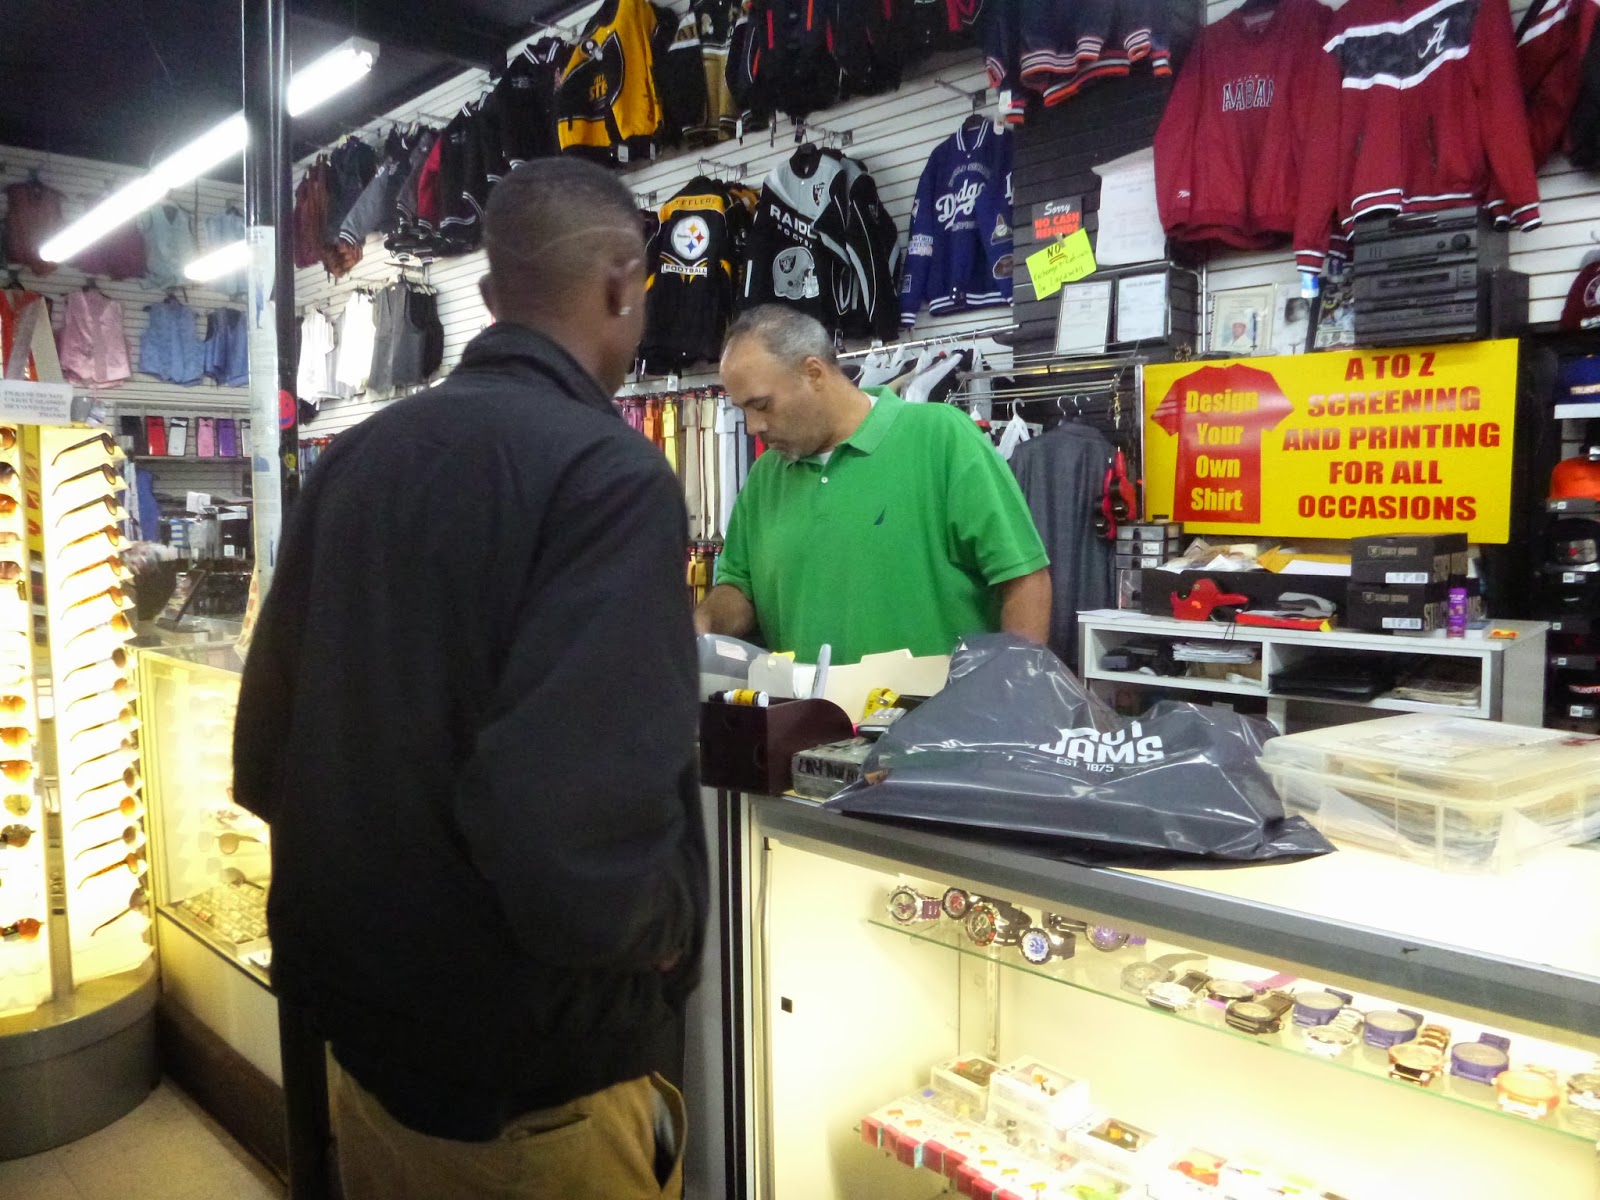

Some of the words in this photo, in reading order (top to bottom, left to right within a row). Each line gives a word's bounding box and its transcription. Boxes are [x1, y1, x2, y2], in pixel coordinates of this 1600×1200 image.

[1034, 217, 1050, 229] NO
[1053, 211, 1080, 225] CASH
[1043, 202, 1071, 216] Sorry
[1047, 244, 1062, 259] NO
[664, 263, 707, 274] FOOTBALL
[1344, 357, 1364, 382] A
[1372, 354, 1414, 380] TO
[1419, 352, 1436, 377] Z
[1185, 389, 1258, 414] Design
[1307, 387, 1480, 417] SCREENING
[1195, 422, 1244, 446] Your
[1282, 427, 1341, 452] AND
[1349, 422, 1501, 450] PRINTING
[1195, 454, 1240, 479] Own
[1329, 461, 1384, 485] FOR
[1390, 460, 1443, 485] ALL
[1190, 486, 1243, 513] Shirt
[1298, 495, 1477, 521] OCCASIONS
[1085, 763, 1115, 773] 1875
